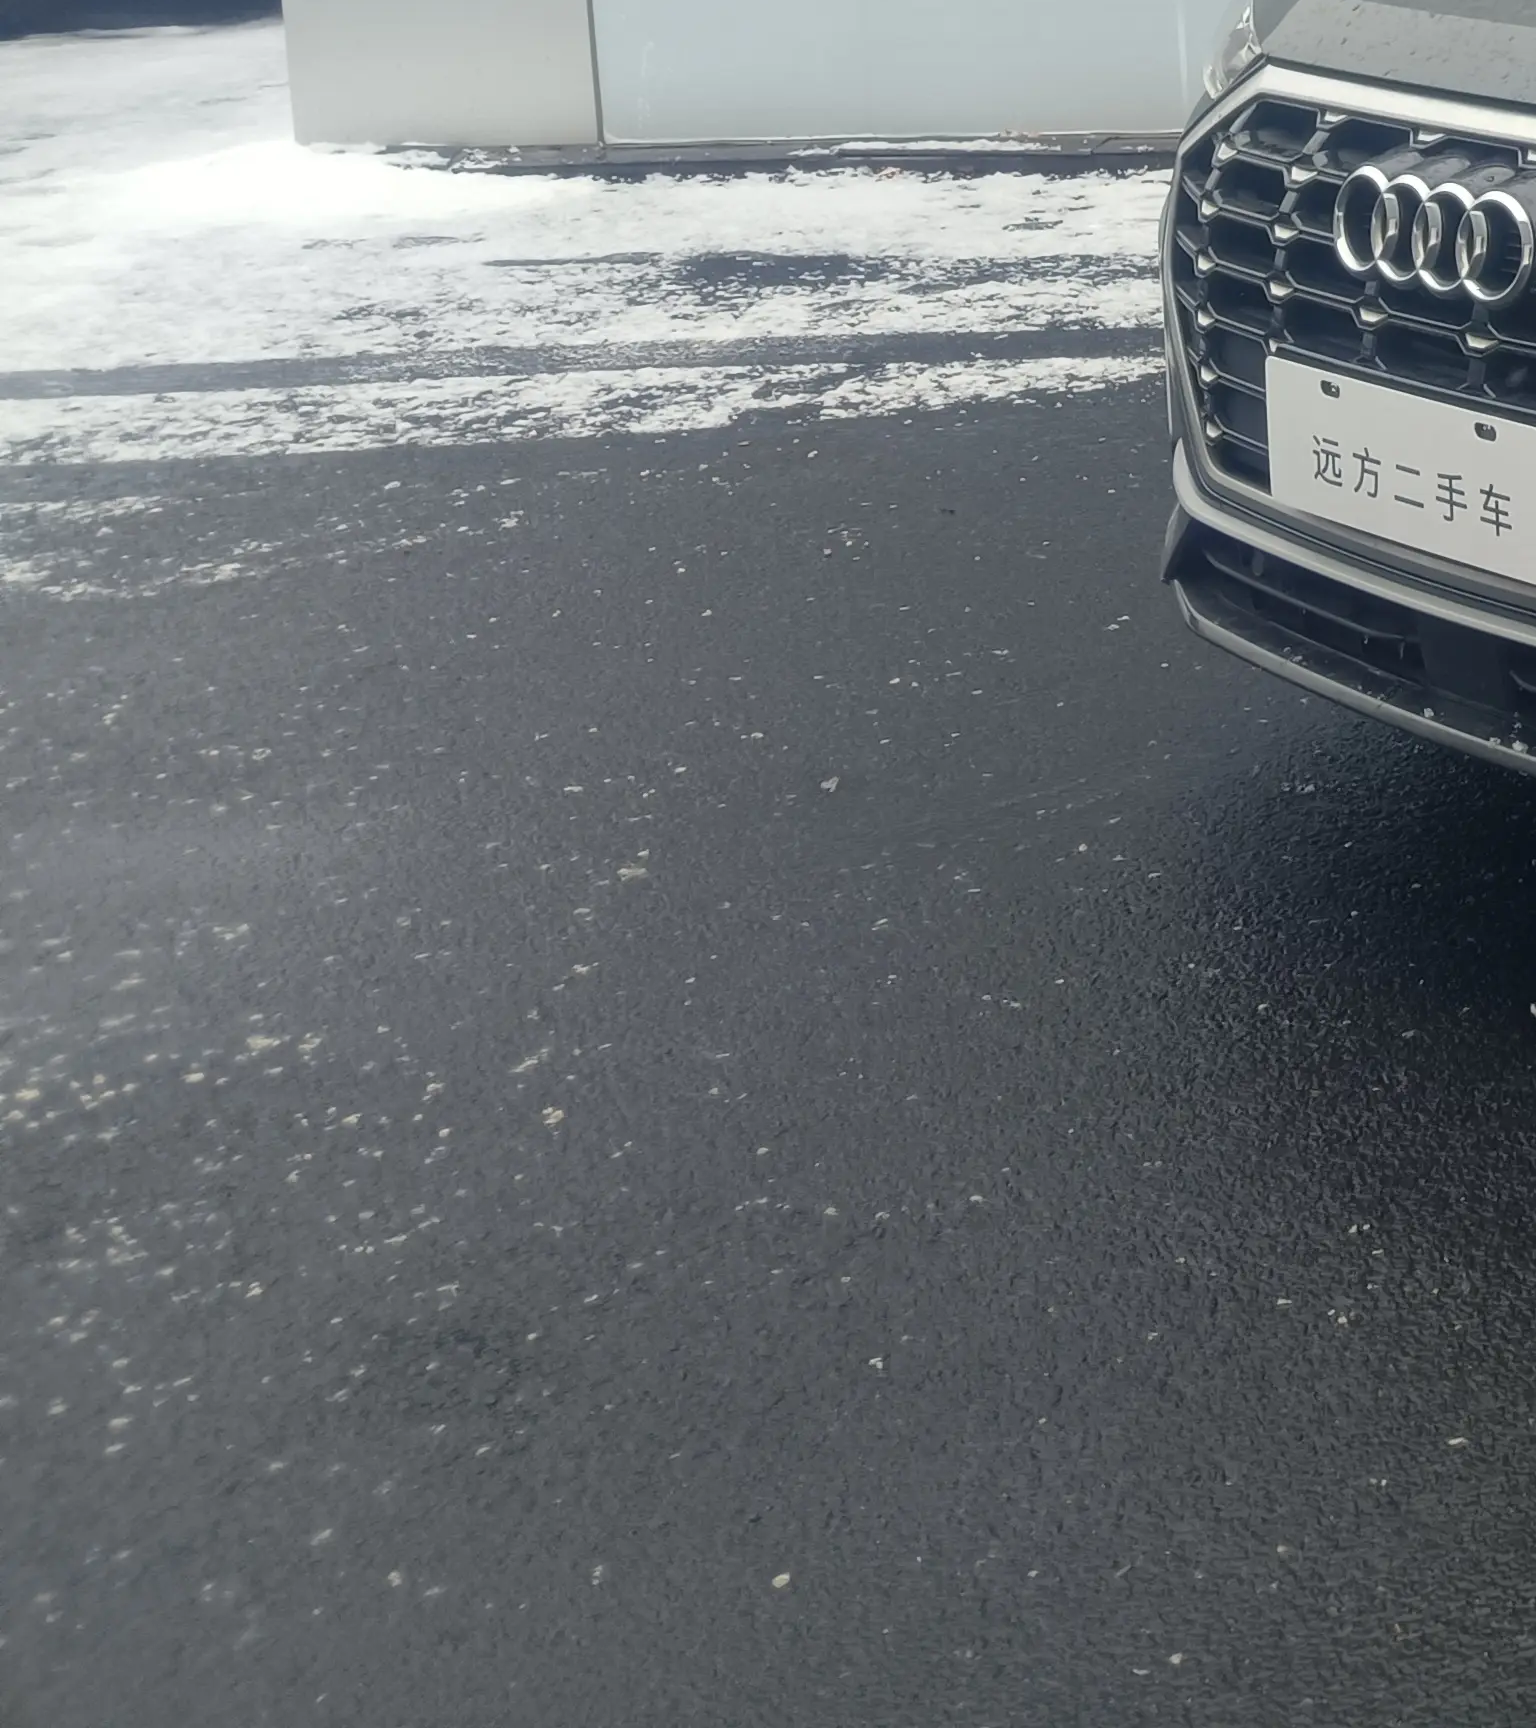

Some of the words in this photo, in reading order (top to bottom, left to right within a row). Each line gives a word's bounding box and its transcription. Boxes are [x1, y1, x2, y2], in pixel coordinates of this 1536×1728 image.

[1311, 434, 1513, 537] 远方二手车
